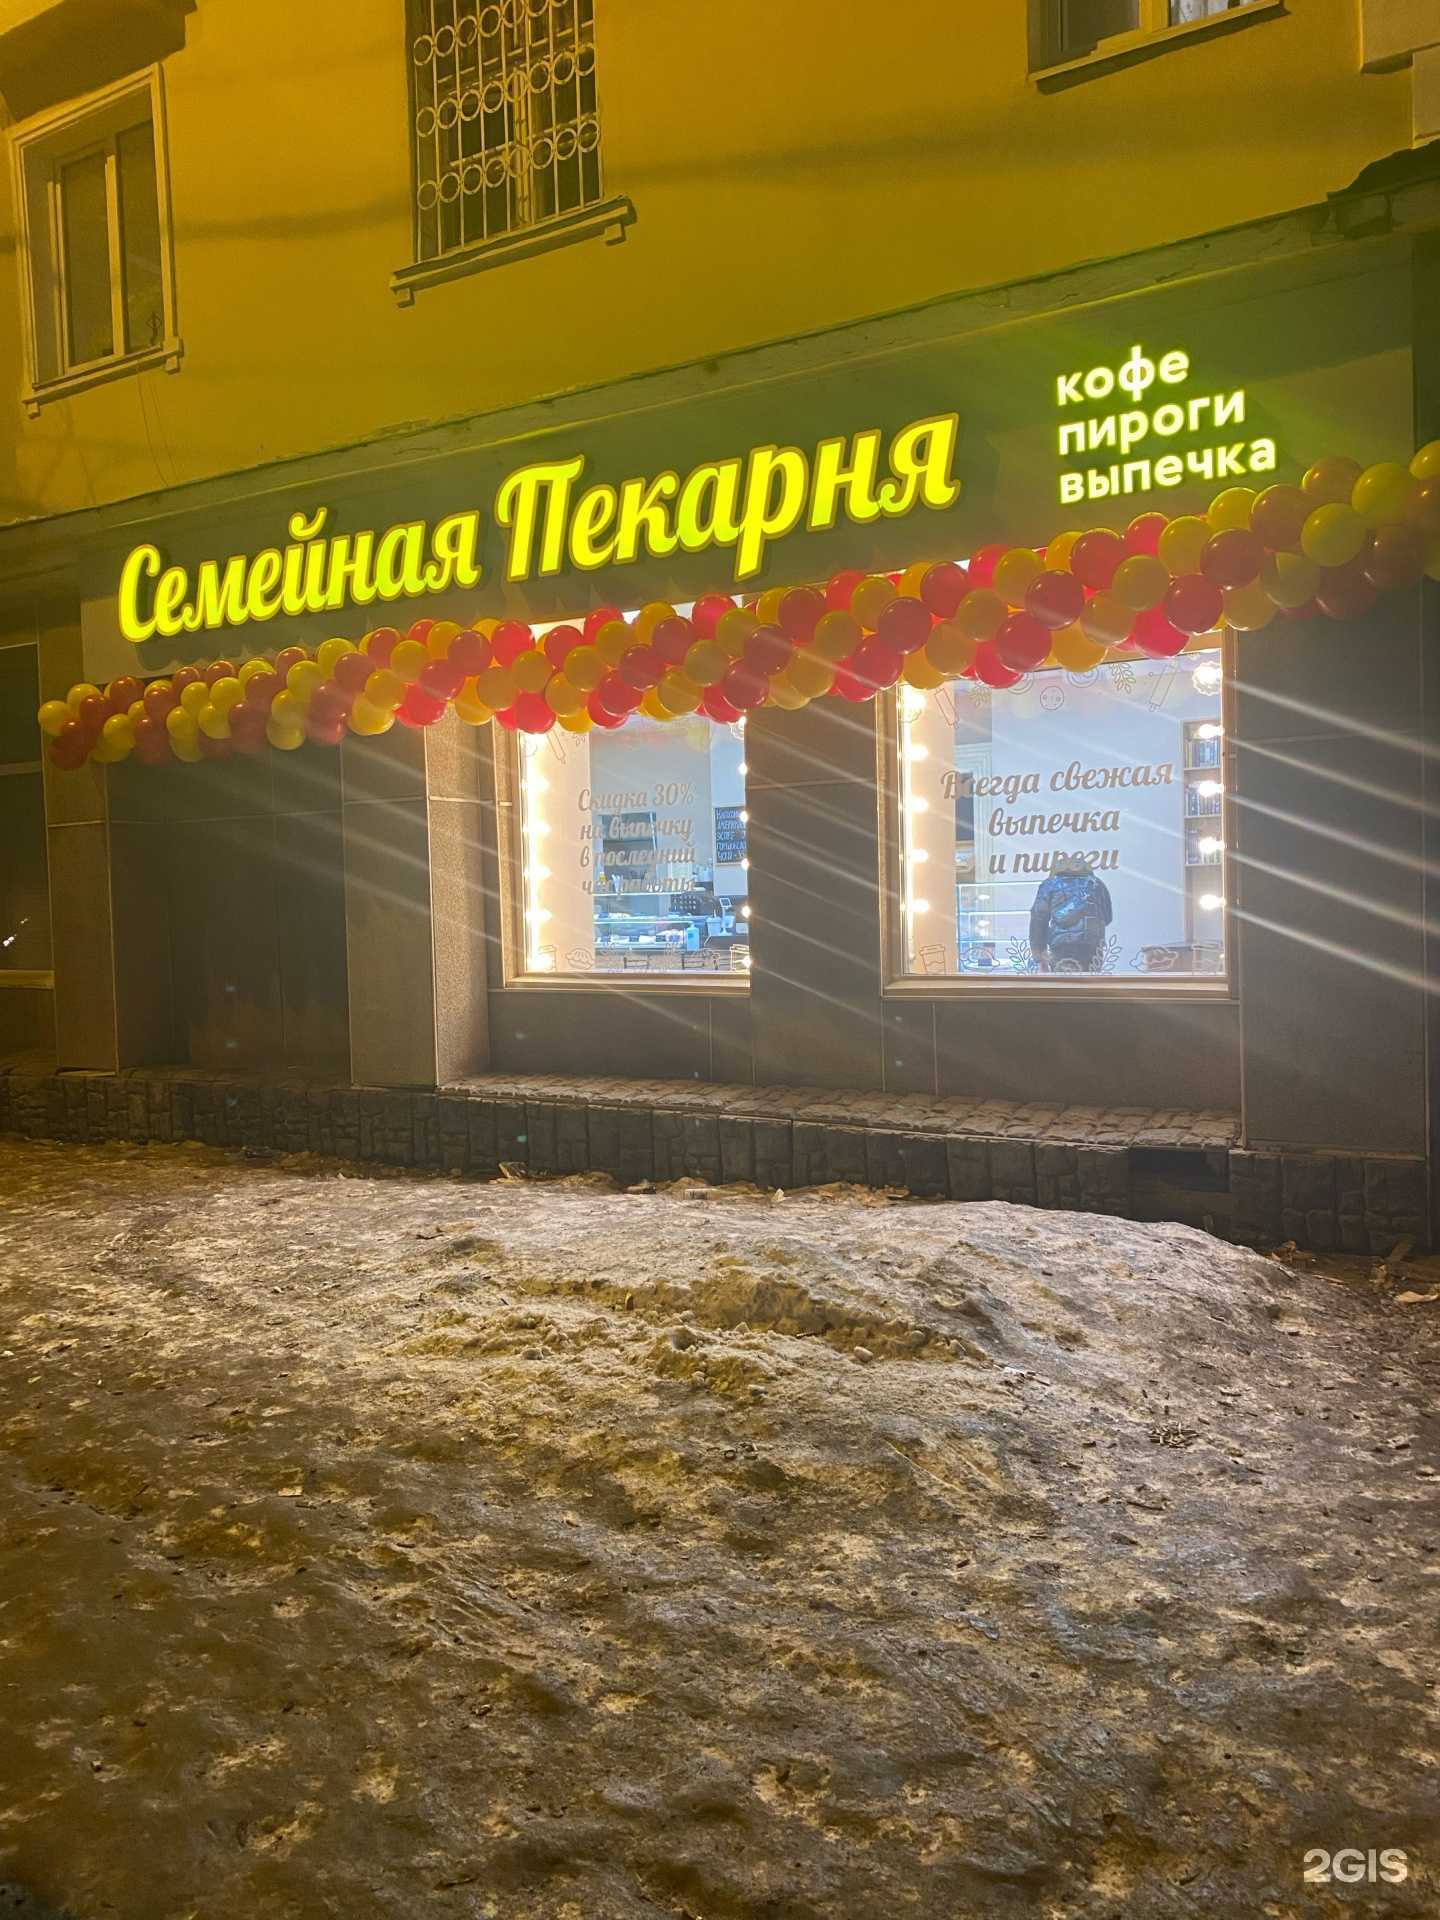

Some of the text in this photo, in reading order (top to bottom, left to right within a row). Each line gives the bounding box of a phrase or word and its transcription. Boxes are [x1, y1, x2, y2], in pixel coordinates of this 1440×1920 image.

[1056, 344, 1190, 403] кофе
[1058, 389, 1246, 456] пироги
[1059, 437, 1276, 505] выпечка
[118, 412, 960, 643] Семейная Пекарня
[577, 782, 695, 817] Скидка 30%
[940, 760, 1174, 804] Всегда свежая
[608, 816, 693, 844] выпчку
[988, 807, 1120, 837] выпечка
[579, 845, 591, 868] в
[988, 853, 1007, 874] и
